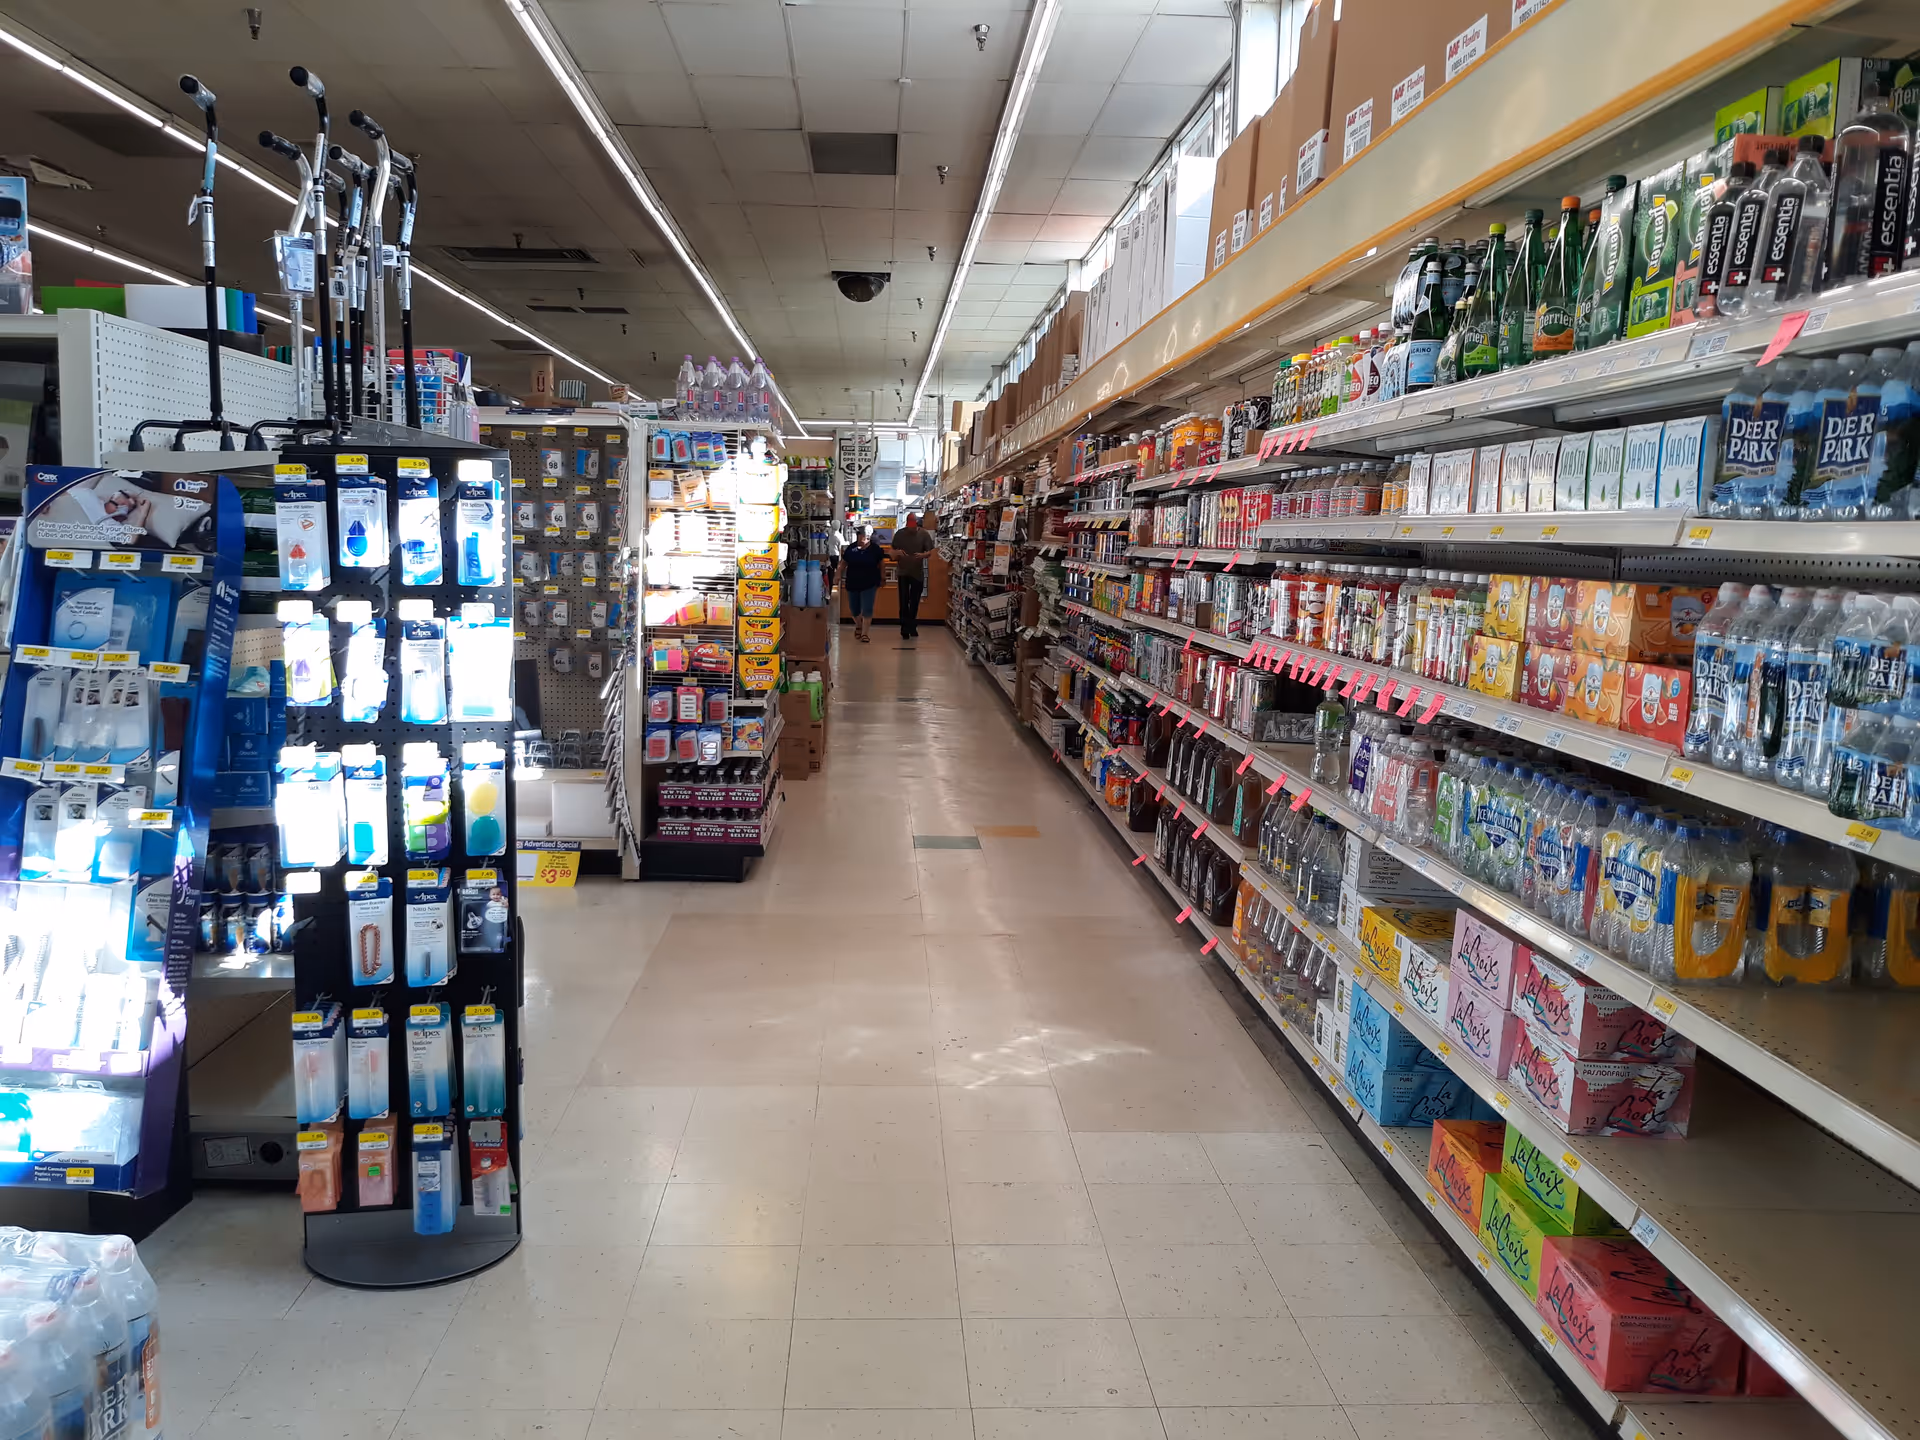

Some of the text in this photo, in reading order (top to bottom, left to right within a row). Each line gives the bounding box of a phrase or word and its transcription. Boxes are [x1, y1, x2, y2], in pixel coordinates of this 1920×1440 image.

[1882, 154, 1902, 246] essentia
[1735, 203, 1757, 265] essentia
[1771, 197, 1796, 261] essentia
[1707, 216, 1726, 275] essentia
[1731, 418, 1780, 441] DEER
[1626, 438, 1657, 474] SHASTA
[1663, 433, 1698, 471] SHASTA
[1727, 439, 1777, 463] PARK
[1821, 436, 1872, 464] PARK
[548, 461, 558, 469] 98
[1558, 447, 1586, 479] SHASTA
[1593, 443, 1621, 477] SHASTA
[287, 489, 307, 499] Apex
[408, 488, 429, 497] Apex
[467, 488, 486, 497] Apex
[520, 513, 530, 521] 94
[585, 513, 595, 521] 60
[38, 521, 56, 529] Have
[72, 523, 104, 533] changed
[105, 525, 122, 534] your
[123, 526, 147, 535] filters,
[38, 530, 59, 538] tubes
[75, 533, 106, 541] cannulas
[107, 533, 132, 542] lately?
[744, 562, 774, 572] MARKERS
[744, 600, 773, 610] MARKERS
[414, 629, 432, 638] Apex
[744, 637, 773, 646] MARKERS
[745, 674, 774, 682] MARKERS
[1478, 807, 1521, 835] ICE MOUNTAIN
[524, 840, 579, 848] Advertised Special
[1607, 860, 1653, 892] ICE MOUNTAIN
[417, 892, 437, 900] Apex
[1595, 1041, 1607, 1051] 12
[1582, 1069, 1631, 1078] PASSIONFRUIT
[1432, 1080, 1452, 1105] La
[1639, 1075, 1666, 1106] La
[1410, 1095, 1456, 1120] Croix
[1607, 1095, 1666, 1129] Croix
[1585, 1116, 1597, 1126] 12
